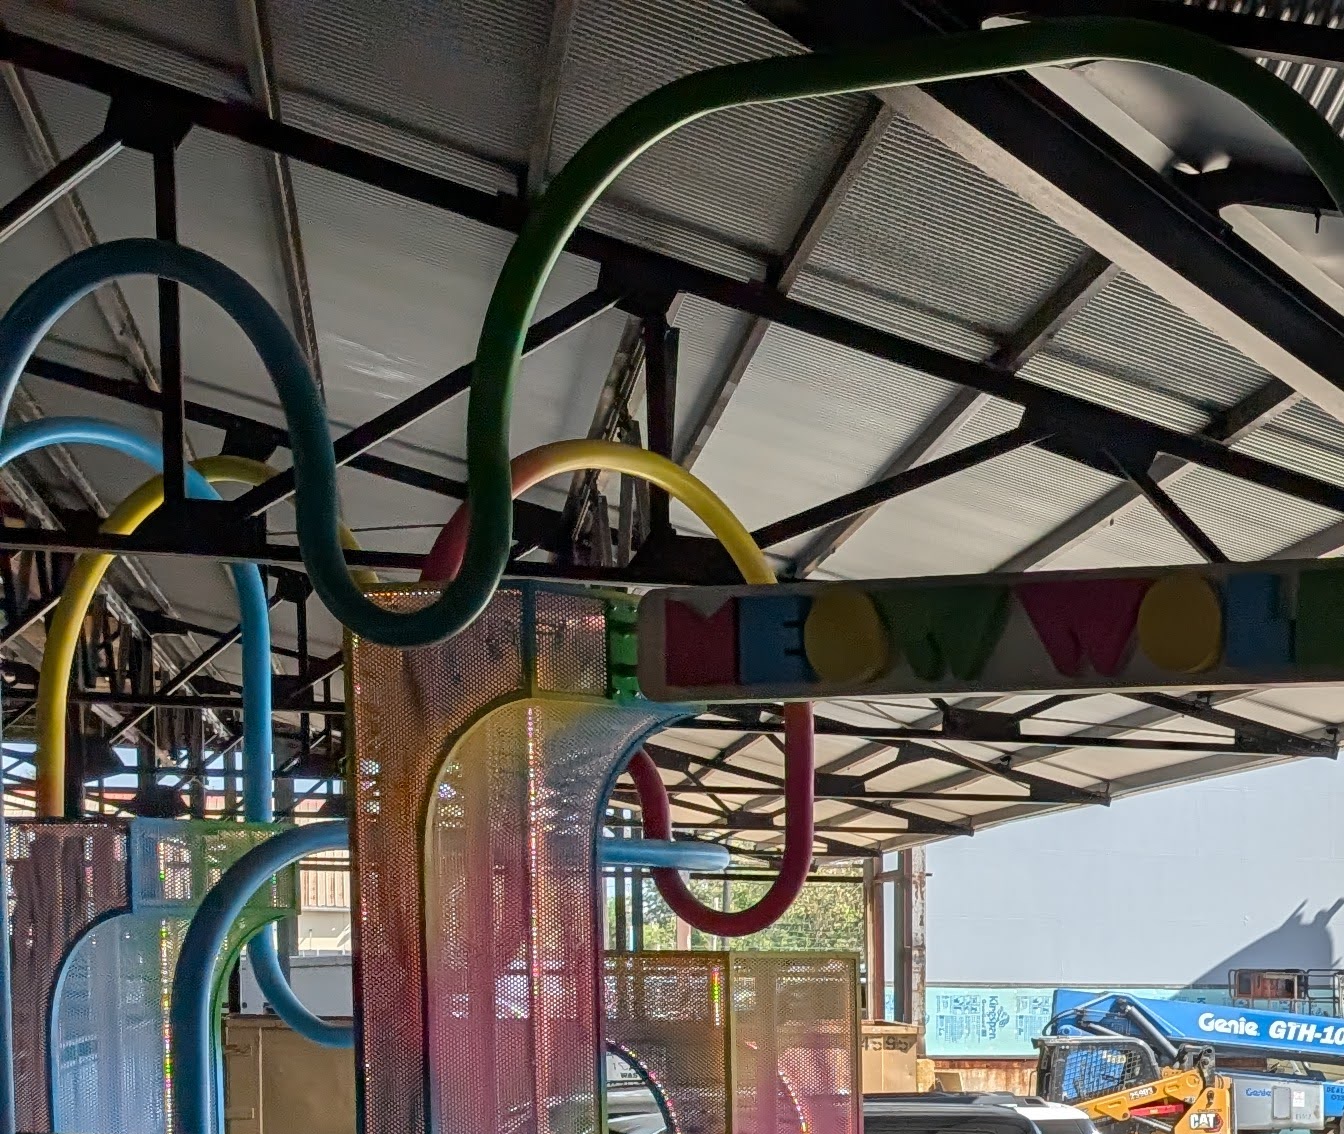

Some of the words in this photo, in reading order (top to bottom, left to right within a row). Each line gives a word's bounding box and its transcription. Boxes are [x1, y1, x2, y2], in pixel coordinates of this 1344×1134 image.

[664, 582, 1011, 687] MEOW
[1198, 1012, 1260, 1037] Genie
[1190, 1113, 1216, 1129] CAT
